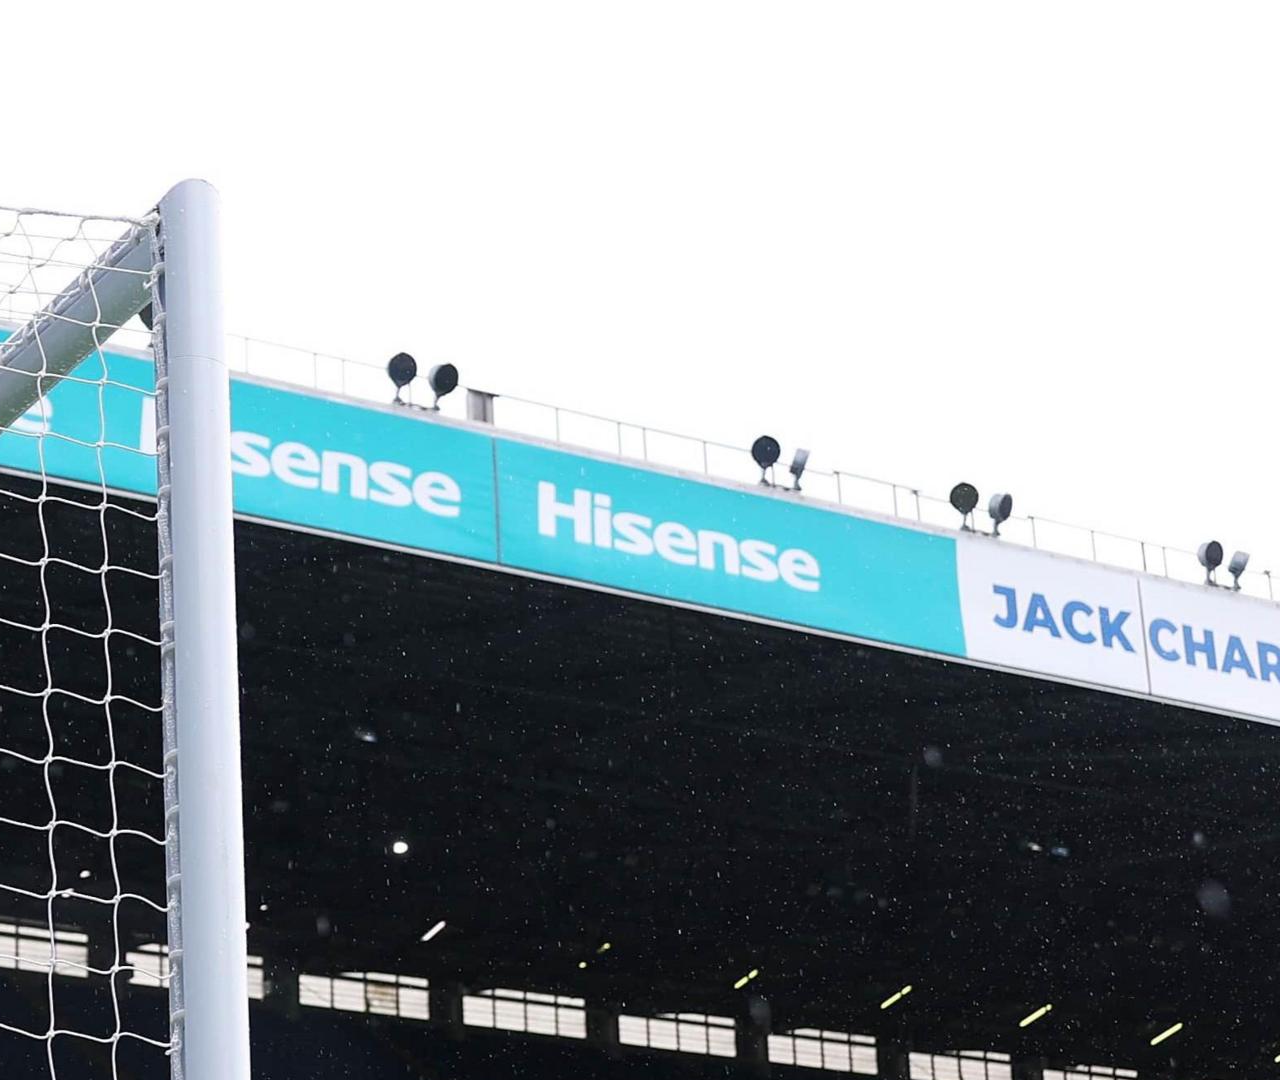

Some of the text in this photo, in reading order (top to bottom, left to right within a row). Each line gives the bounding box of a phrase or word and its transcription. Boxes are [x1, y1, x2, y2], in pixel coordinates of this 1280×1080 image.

[140, 397, 462, 518] sense
[538, 481, 820, 592] Hisense
[992, 584, 1137, 653] JACK
